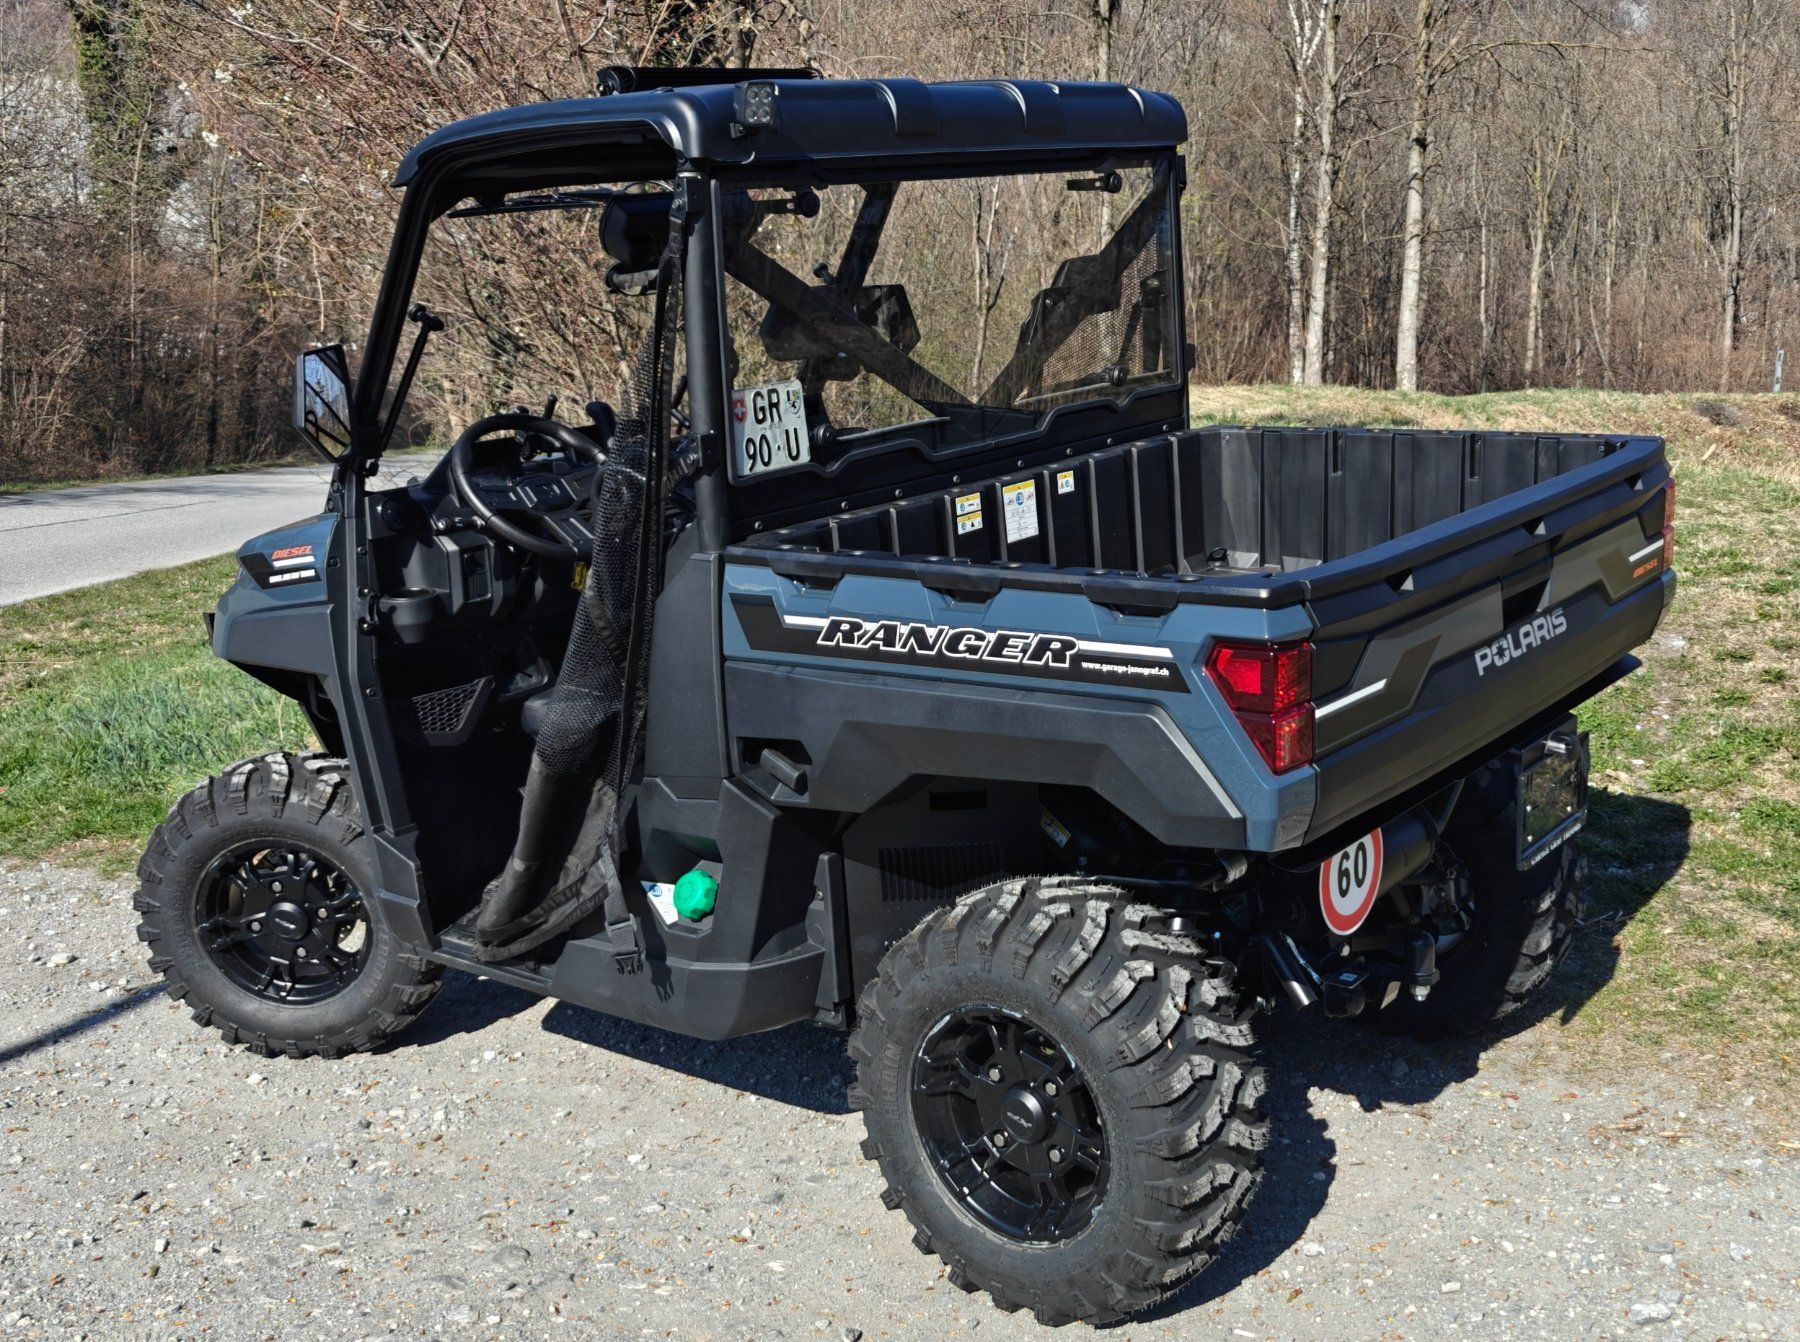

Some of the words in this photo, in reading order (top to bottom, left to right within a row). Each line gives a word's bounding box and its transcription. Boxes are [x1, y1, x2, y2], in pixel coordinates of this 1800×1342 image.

[752, 387, 782, 425] GR
[271, 545, 312, 560] DIESEL
[816, 615, 1080, 668] RANGER
[1474, 607, 1568, 677] POLARIS
[1338, 841, 1368, 898] 60
